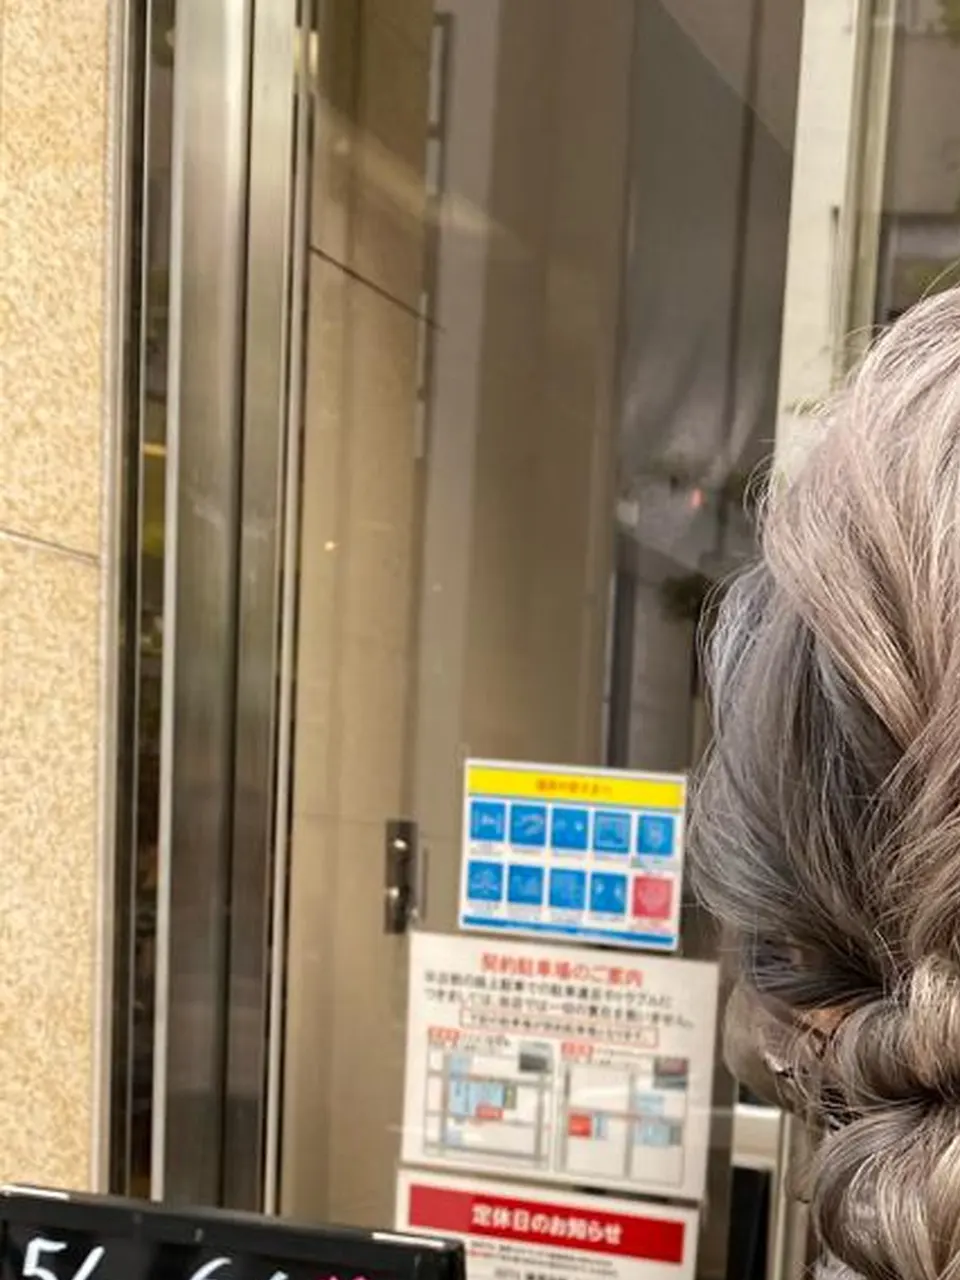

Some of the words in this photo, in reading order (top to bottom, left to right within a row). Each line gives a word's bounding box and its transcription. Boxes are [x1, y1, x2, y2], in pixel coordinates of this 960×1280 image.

[480, 952, 644, 987] 契約駐車場のご案内
[471, 1203, 623, 1245] 定休日のお知らせ
